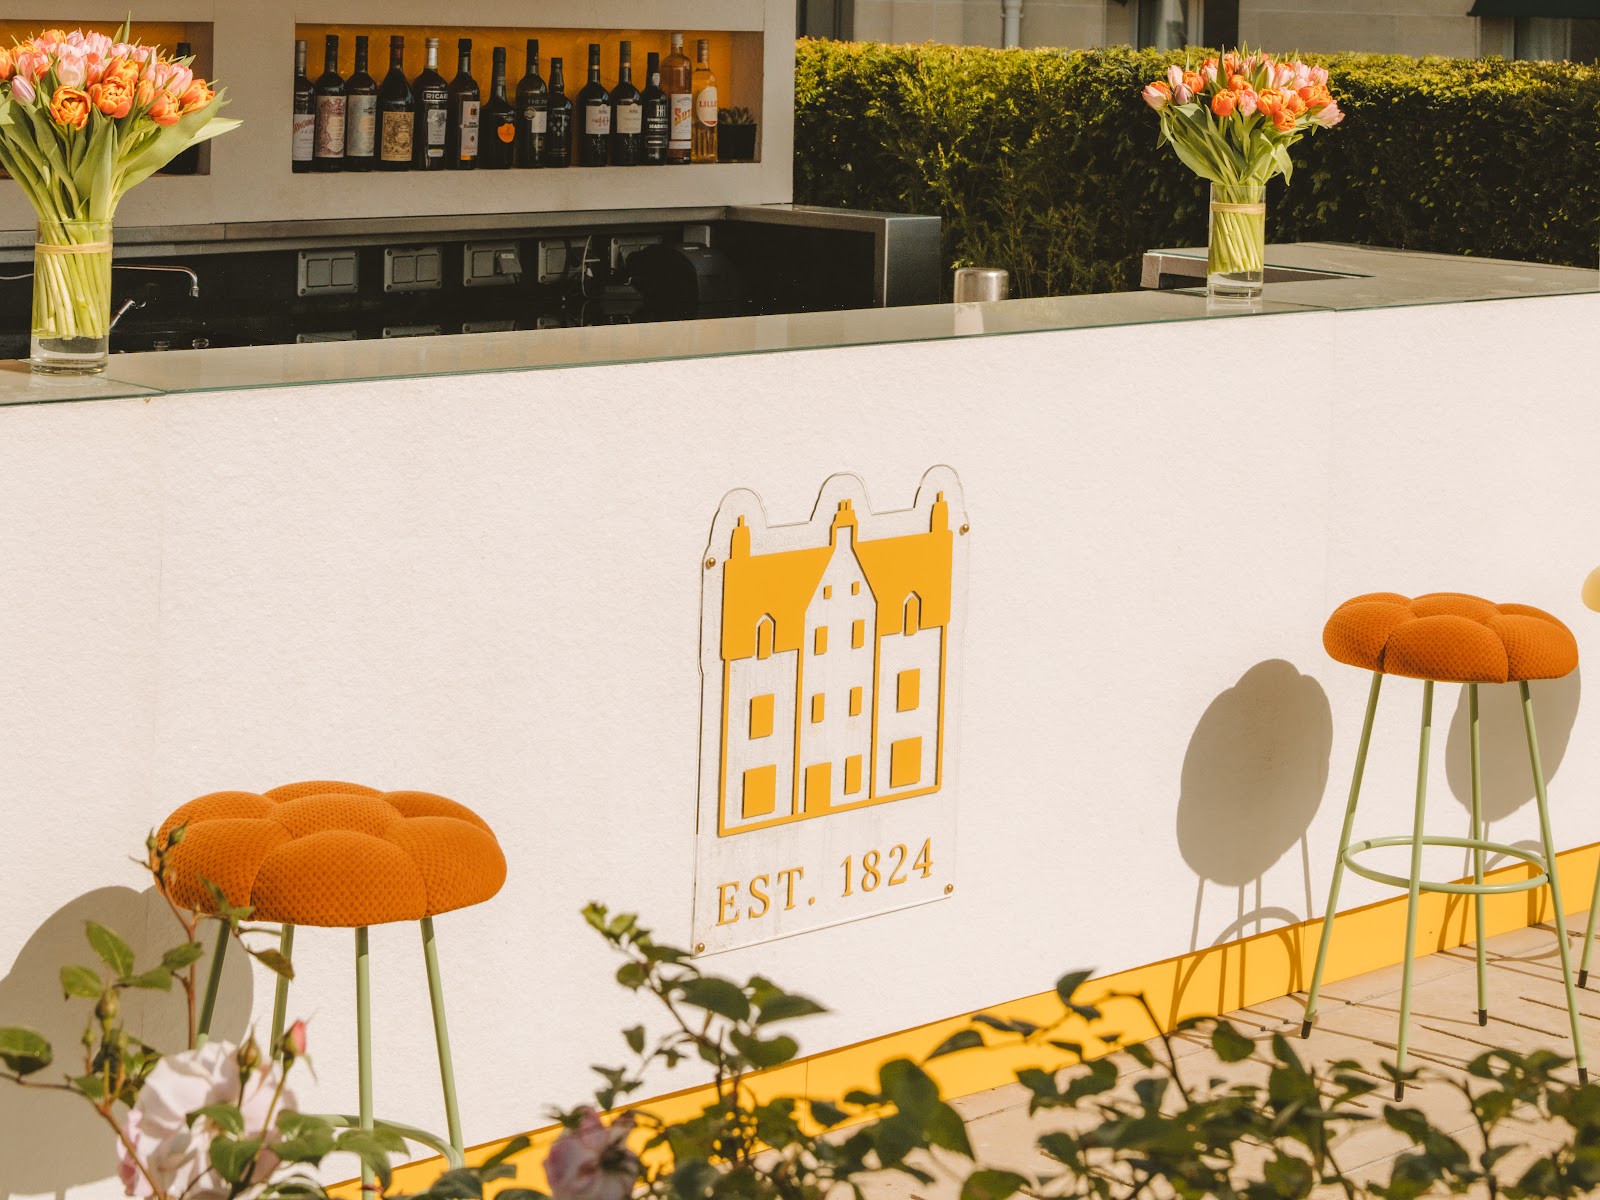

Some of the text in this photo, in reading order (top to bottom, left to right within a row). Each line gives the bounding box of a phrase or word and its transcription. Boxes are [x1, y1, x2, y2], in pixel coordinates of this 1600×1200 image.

[674, 107, 691, 126] Suz
[715, 836, 934, 927] EST. 1824
